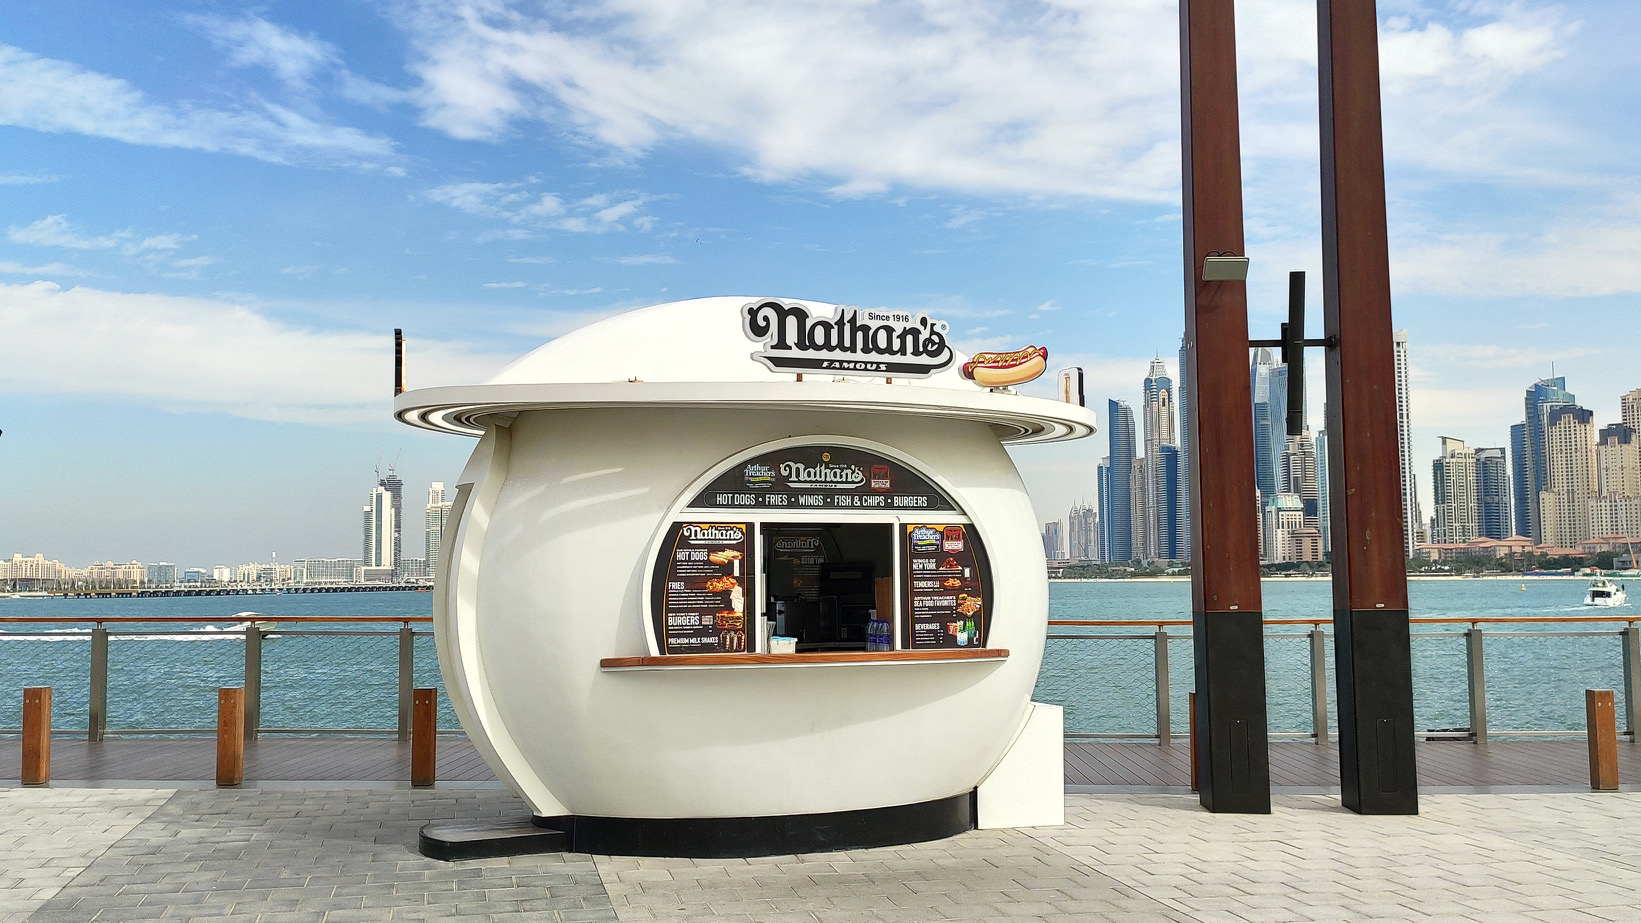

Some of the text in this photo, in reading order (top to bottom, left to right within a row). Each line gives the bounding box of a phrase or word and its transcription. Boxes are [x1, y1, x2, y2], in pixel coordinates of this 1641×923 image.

[868, 312, 909, 323] Since 1916
[748, 301, 954, 358] Nathan's
[822, 361, 888, 371] FAMOUS
[780, 461, 866, 483] Nathan's
[717, 494, 928, 507] HOT DOGS FRIES WINGS FISH & CHIPS BURGERS
[683, 525, 744, 540] Nathan's
[676, 551, 708, 561] HOT DOGS
[668, 616, 700, 625] BURGERS
